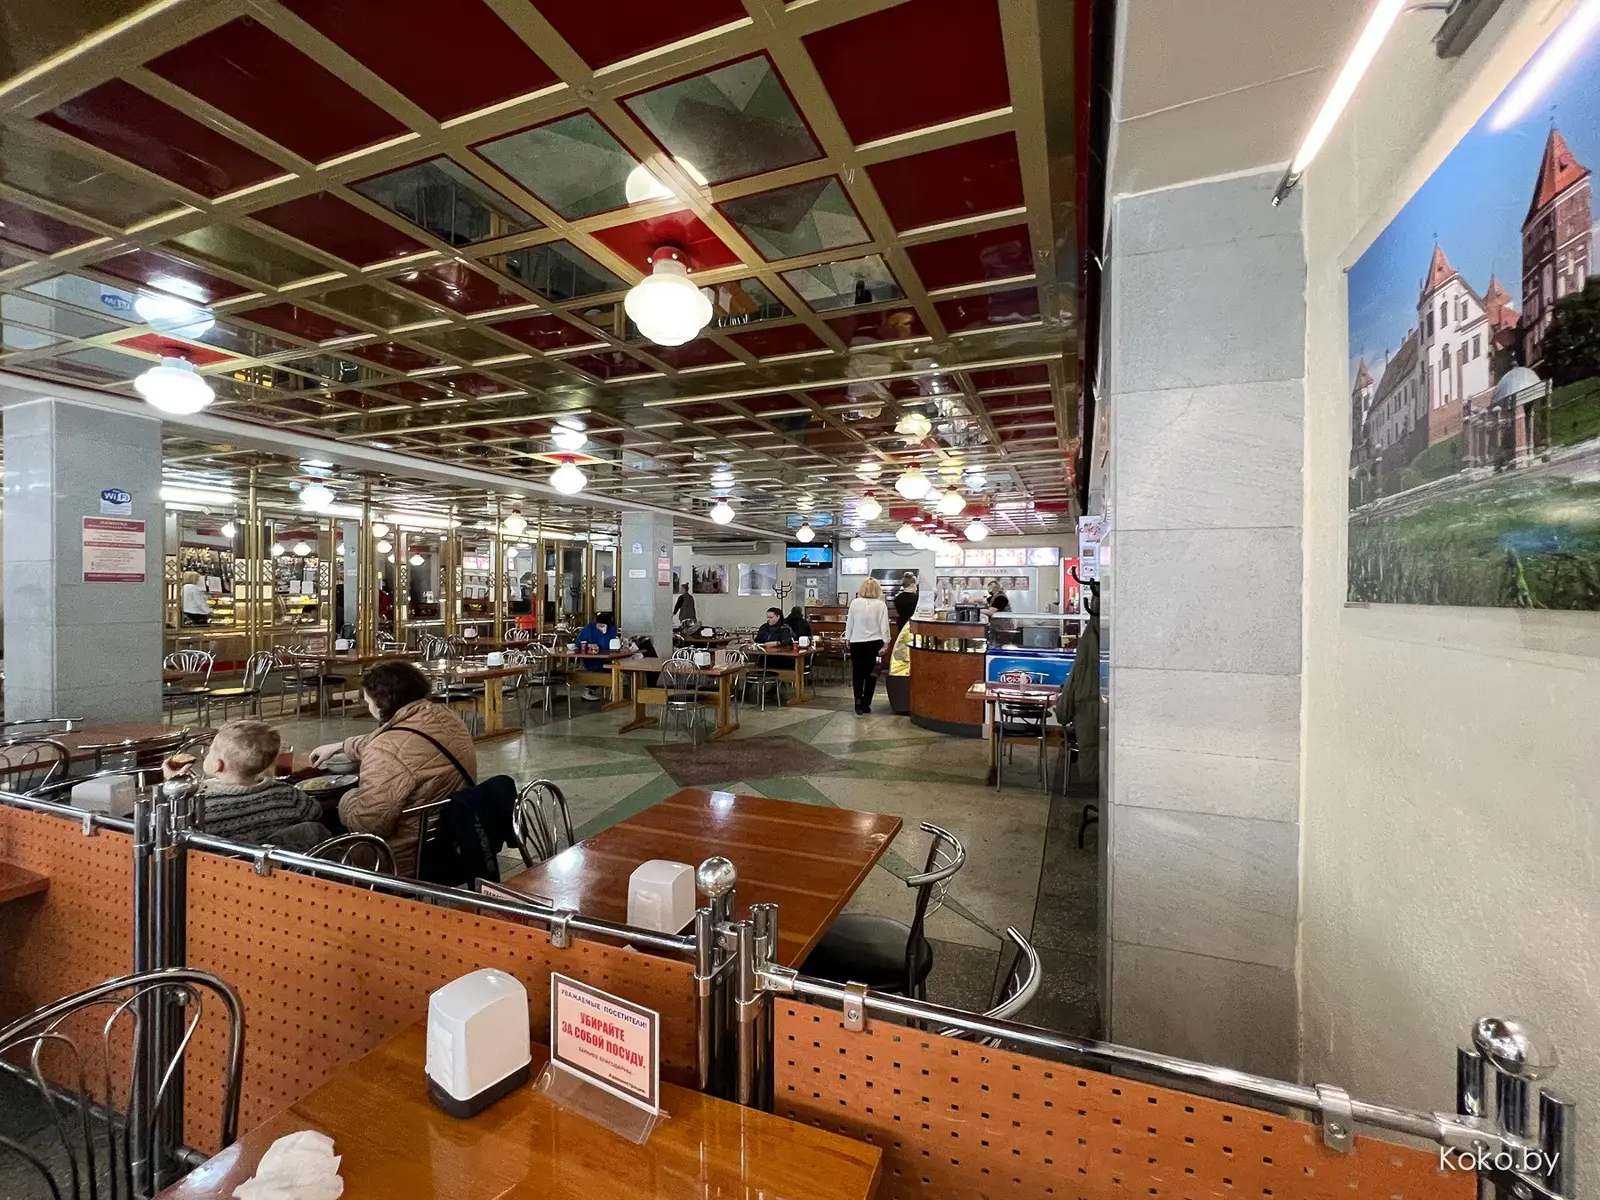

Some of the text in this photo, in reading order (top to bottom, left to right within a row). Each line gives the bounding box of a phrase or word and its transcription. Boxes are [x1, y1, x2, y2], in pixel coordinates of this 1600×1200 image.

[561, 988, 648, 1029] УВАЖАЕМЫЕ ПОСЕТИТЕЛИ!
[580, 1012, 625, 1042] УБИРАЙТЕ
[561, 1020, 646, 1069] ЗА СОБОЙ ПОСУДУ.
